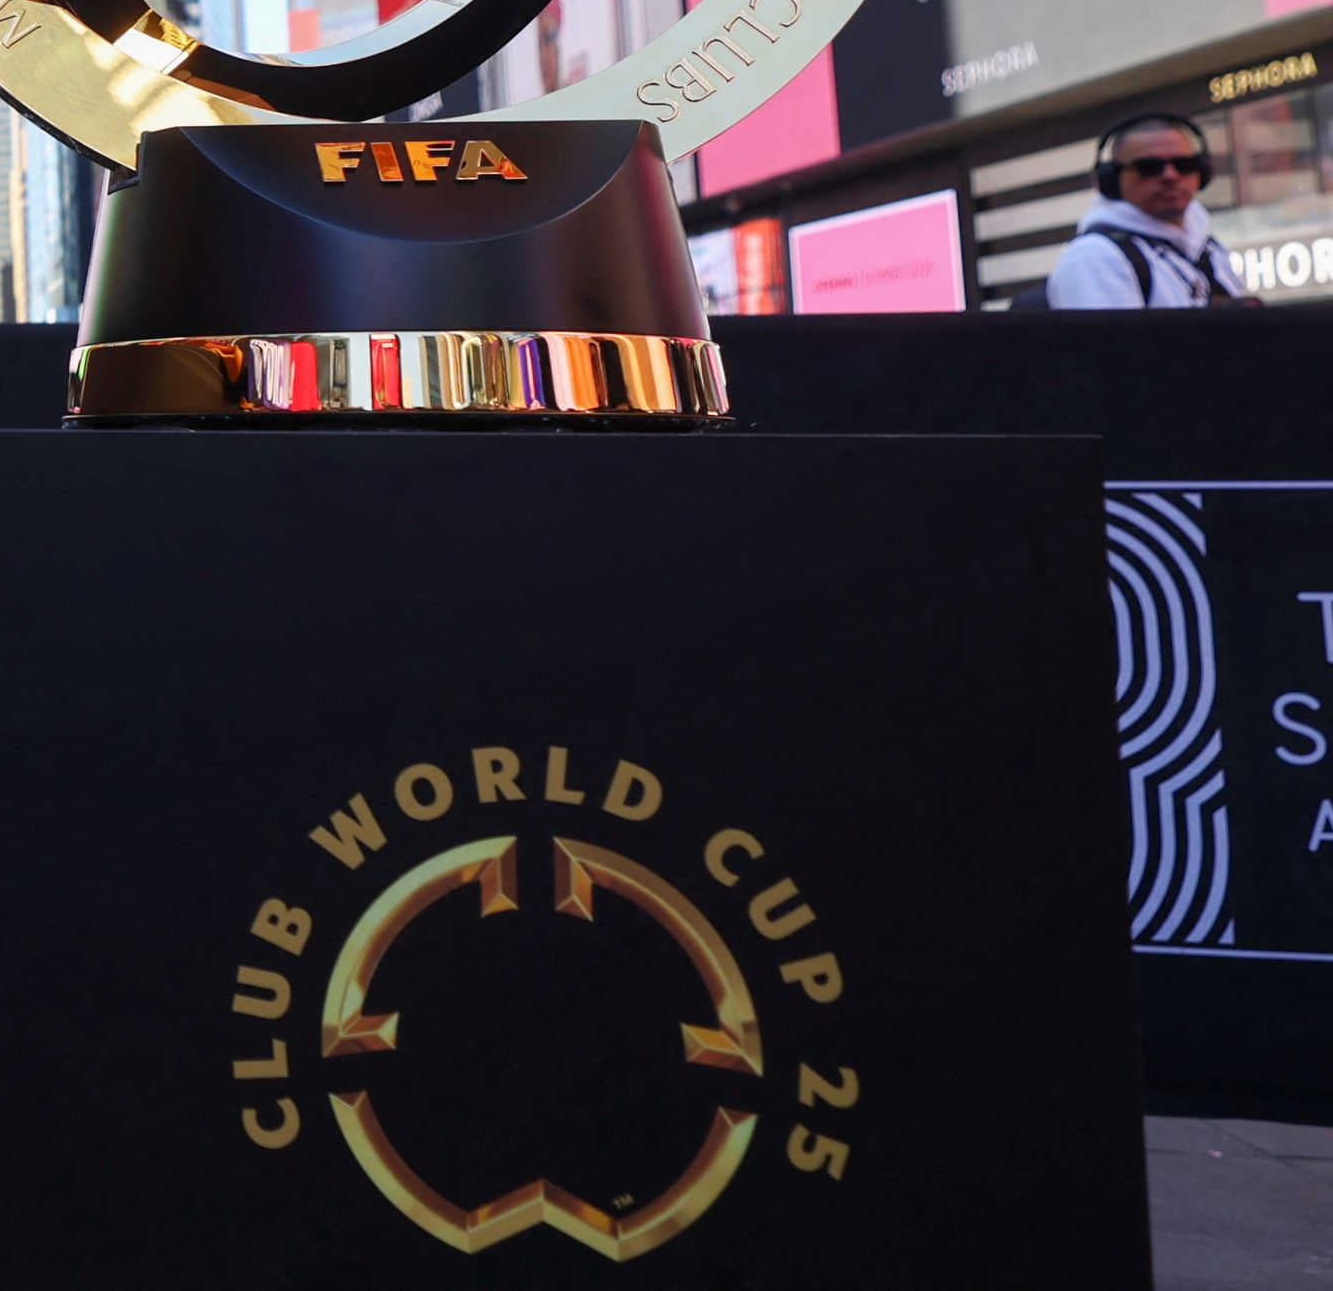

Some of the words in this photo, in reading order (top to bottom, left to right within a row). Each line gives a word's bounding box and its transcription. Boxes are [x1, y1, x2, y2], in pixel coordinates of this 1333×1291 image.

[941, 40, 1039, 96] SEPHORA
[1208, 52, 1319, 103] SEPHORA
[314, 140, 529, 183] FIFA
[232, 895, 314, 1150] CLUB
[307, 744, 664, 872] WORLD
[701, 826, 845, 1007] CUP
[786, 1061, 861, 1181] 25
